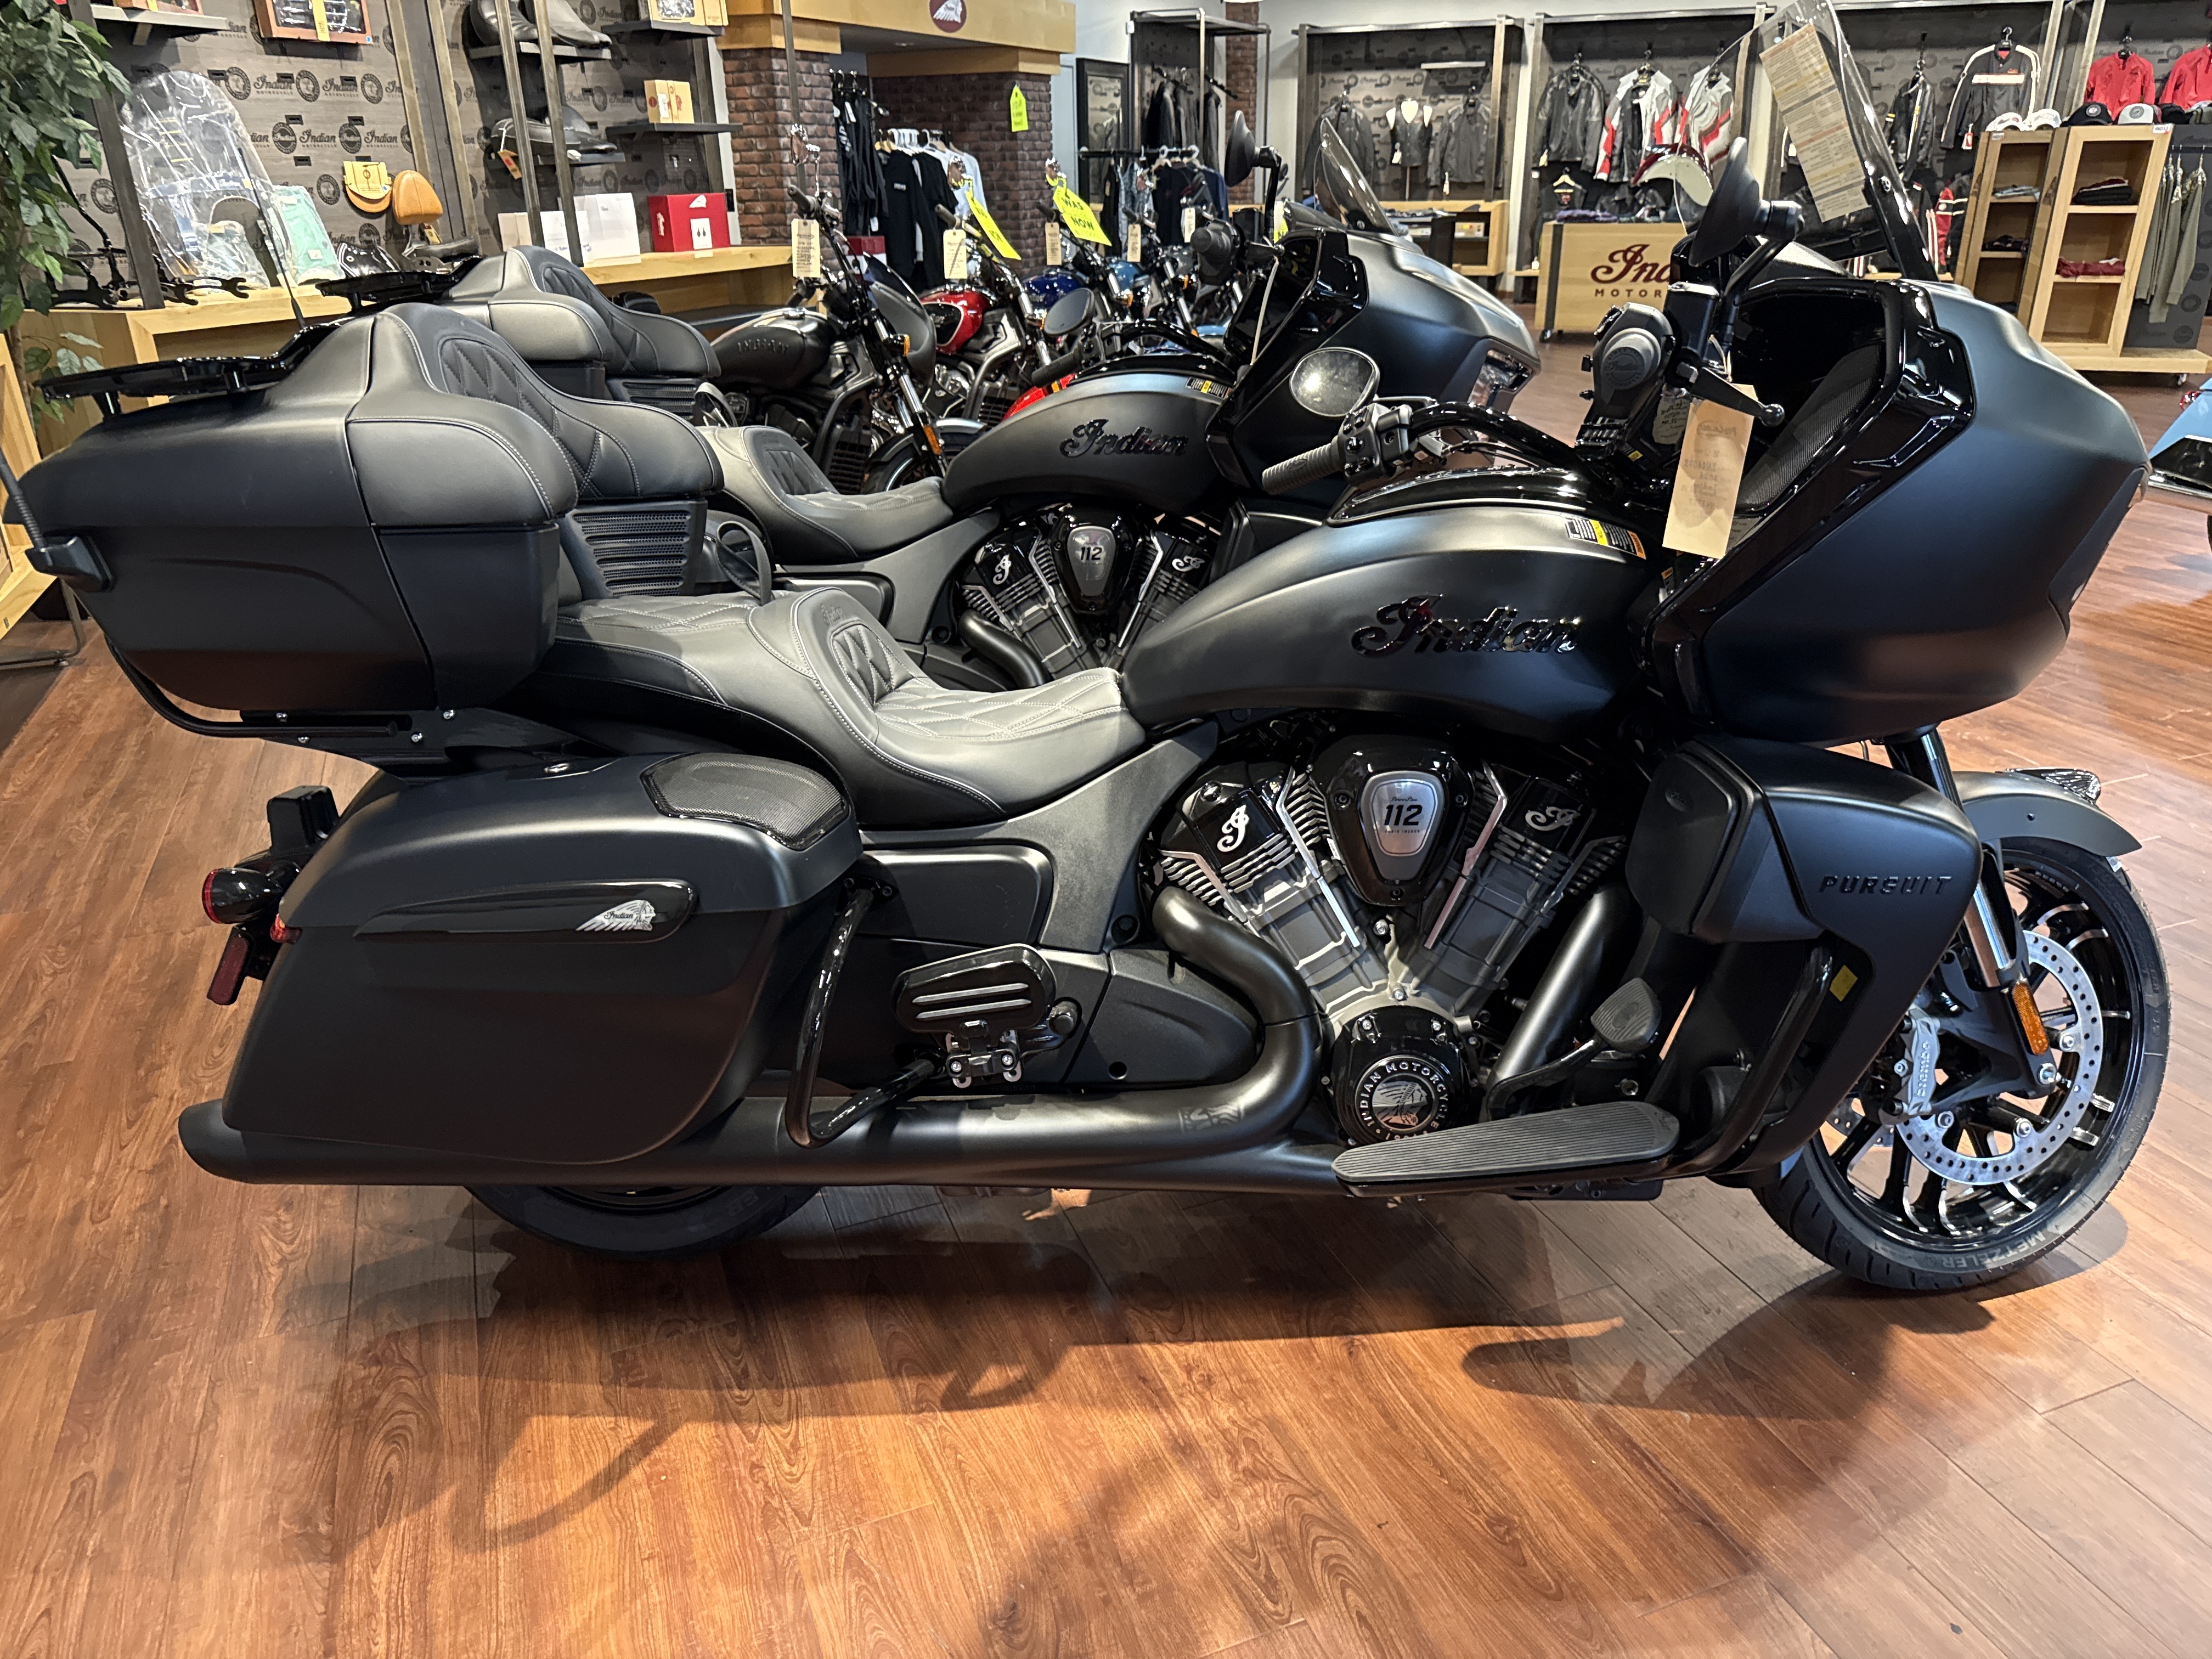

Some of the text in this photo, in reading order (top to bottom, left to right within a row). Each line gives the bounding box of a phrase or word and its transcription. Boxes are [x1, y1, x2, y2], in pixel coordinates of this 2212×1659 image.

[299, 129, 336, 143] Indian
[364, 130, 398, 143] Indian
[1062, 197, 1084, 211] WAS
[1070, 216, 1094, 231] NOW
[1594, 289, 1662, 298] MOTOR
[1059, 419, 1189, 458] Indian
[1080, 546, 1102, 561] 112
[1351, 594, 1583, 657] Indian
[1384, 804, 1423, 826] 112
[1818, 875, 1953, 895] PURSUIT
[603, 911, 634, 919] Indian
[1917, 1040, 1931, 1097] brembo
[1359, 1061, 1449, 1130] INDIAN MOTORCYCLE
[1942, 1231, 2046, 1268] METZELER
